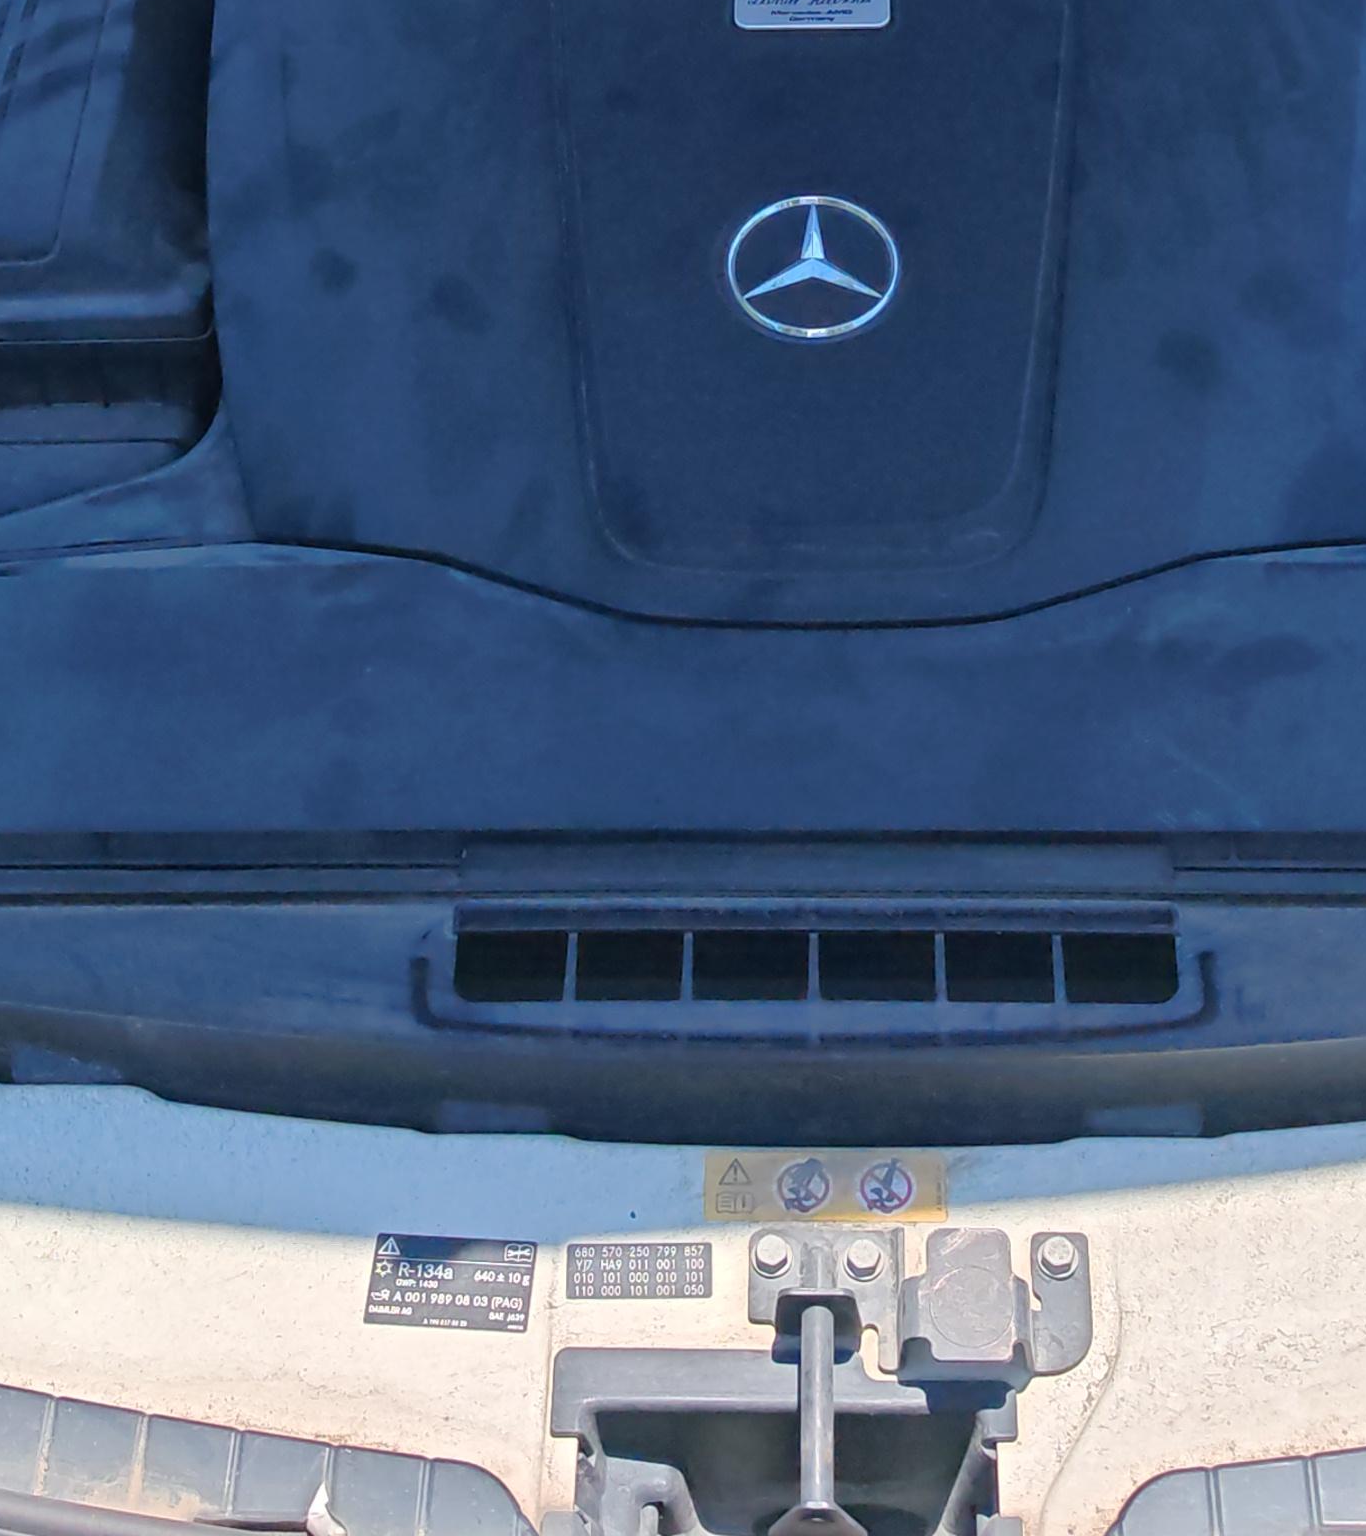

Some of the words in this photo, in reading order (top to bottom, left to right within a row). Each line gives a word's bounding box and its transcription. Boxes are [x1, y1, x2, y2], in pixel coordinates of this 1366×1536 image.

[574, 1247, 595, 1258] 680
[602, 1246, 623, 1257] 570
[629, 1246, 650, 1257] 250
[656, 1246, 676, 1257] 799
[683, 1245, 704, 1257] 857
[398, 1261, 454, 1280] R-134a
[600, 1259, 622, 1270] HA9
[629, 1259, 649, 1270] 011
[656, 1259, 676, 1270] 001
[685, 1258, 704, 1270] 100
[473, 1270, 496, 1282] 640
[508, 1272, 521, 1283] 10
[573, 1272, 594, 1284] 010
[602, 1272, 622, 1283] 101
[628, 1272, 649, 1283] 000
[656, 1272, 677, 1283] 010
[685, 1271, 704, 1283] 101
[574, 1285, 594, 1296] 110
[600, 1285, 622, 1296] 000
[630, 1285, 649, 1296] 101
[656, 1285, 676, 1296] 001
[683, 1284, 704, 1296] 050
[392, 1292, 402, 1302] A
[404, 1292, 426, 1303] 001
[430, 1293, 452, 1305] 989
[455, 1295, 470, 1306] 08
[473, 1295, 488, 1307] 03
[490, 1296, 523, 1311] (PAG)
